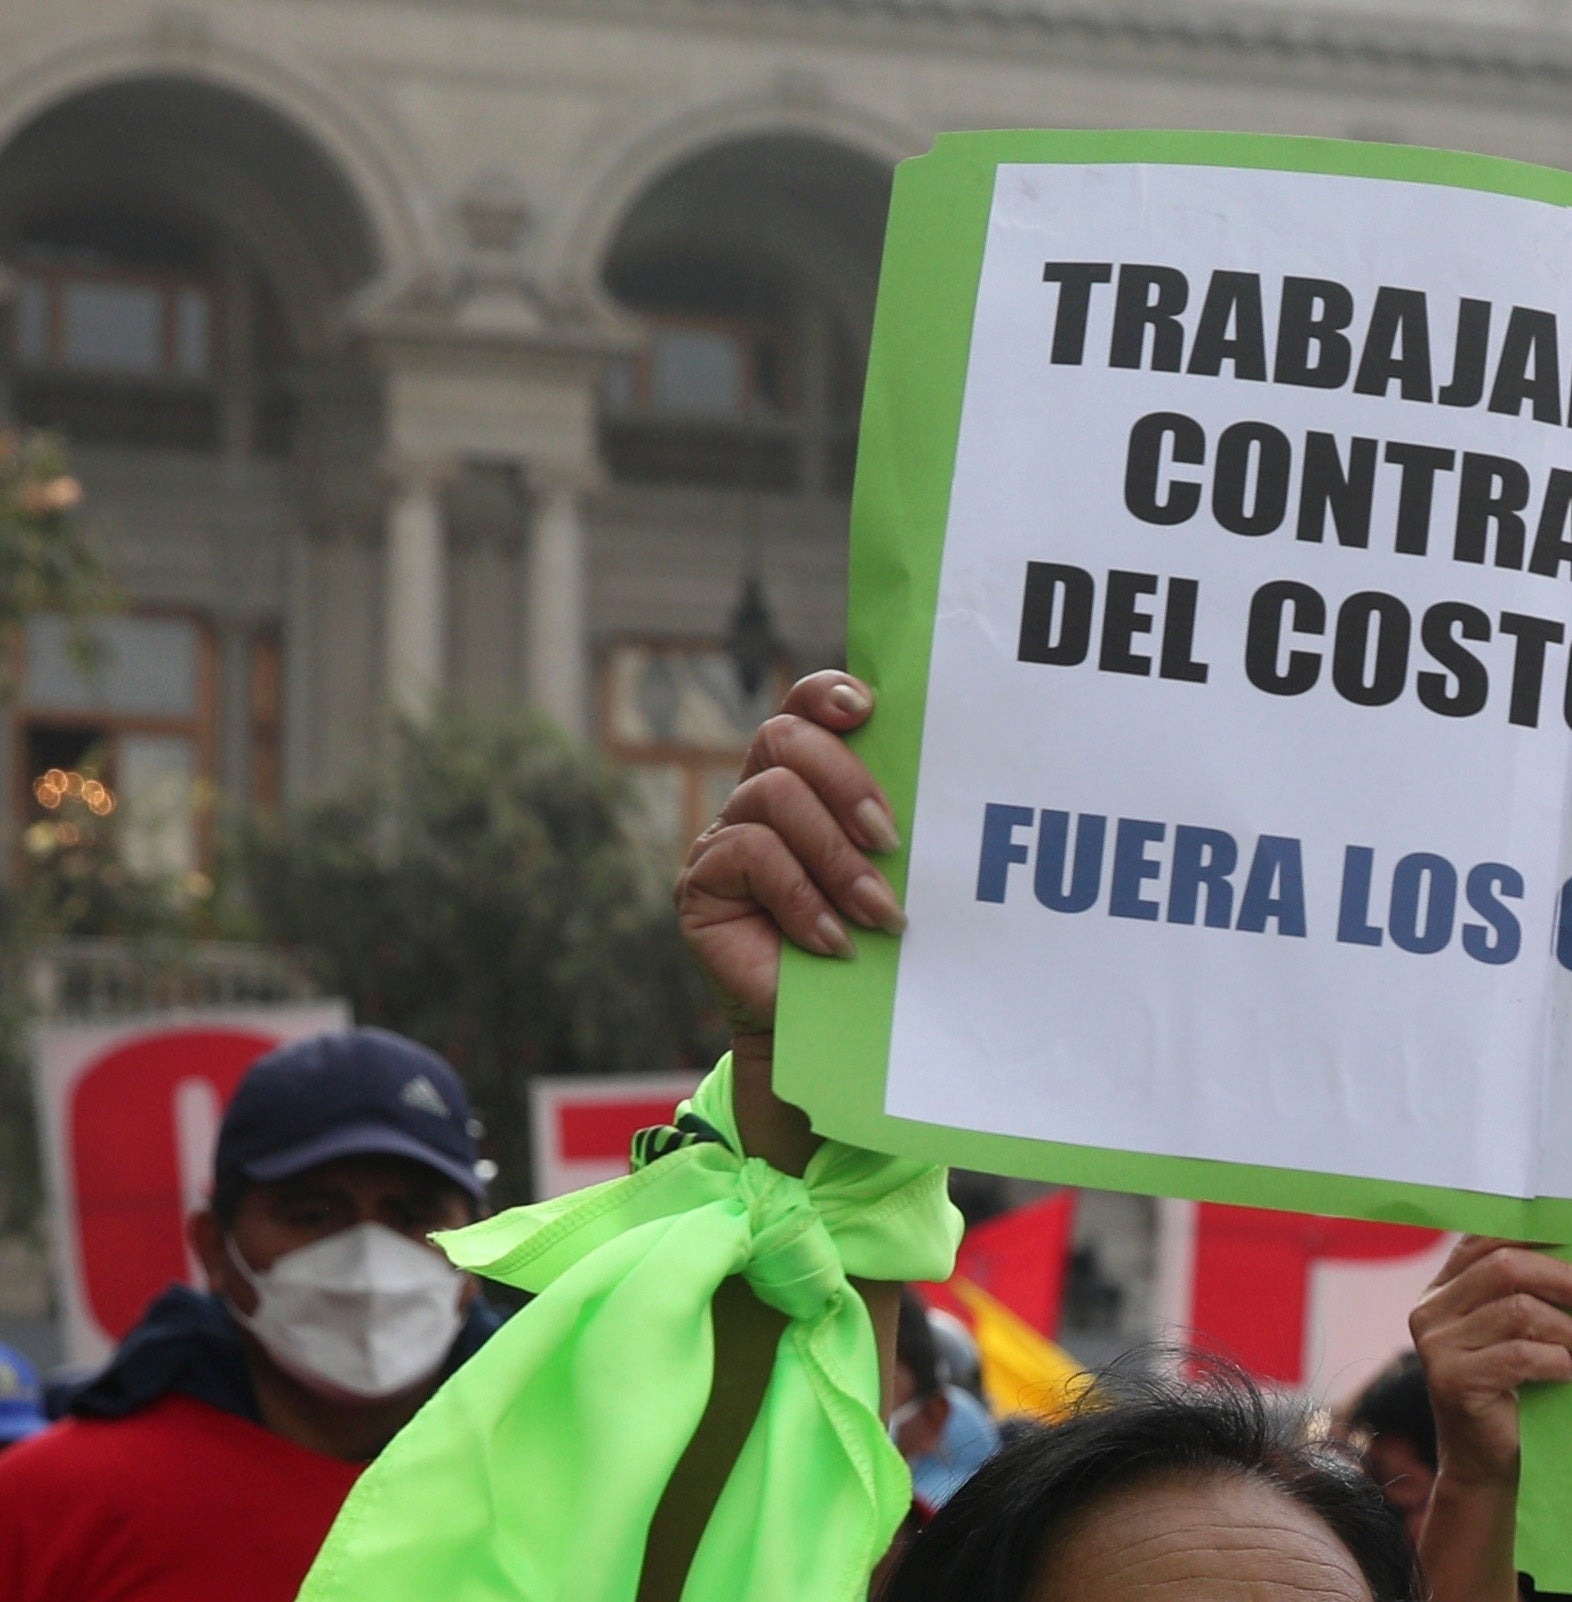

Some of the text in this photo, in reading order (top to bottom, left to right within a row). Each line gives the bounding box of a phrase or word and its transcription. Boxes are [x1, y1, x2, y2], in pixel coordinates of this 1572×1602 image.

[1016, 560, 1209, 684] DEL
[975, 802, 1306, 938] FUERA
[1336, 845, 1523, 965] LOS
